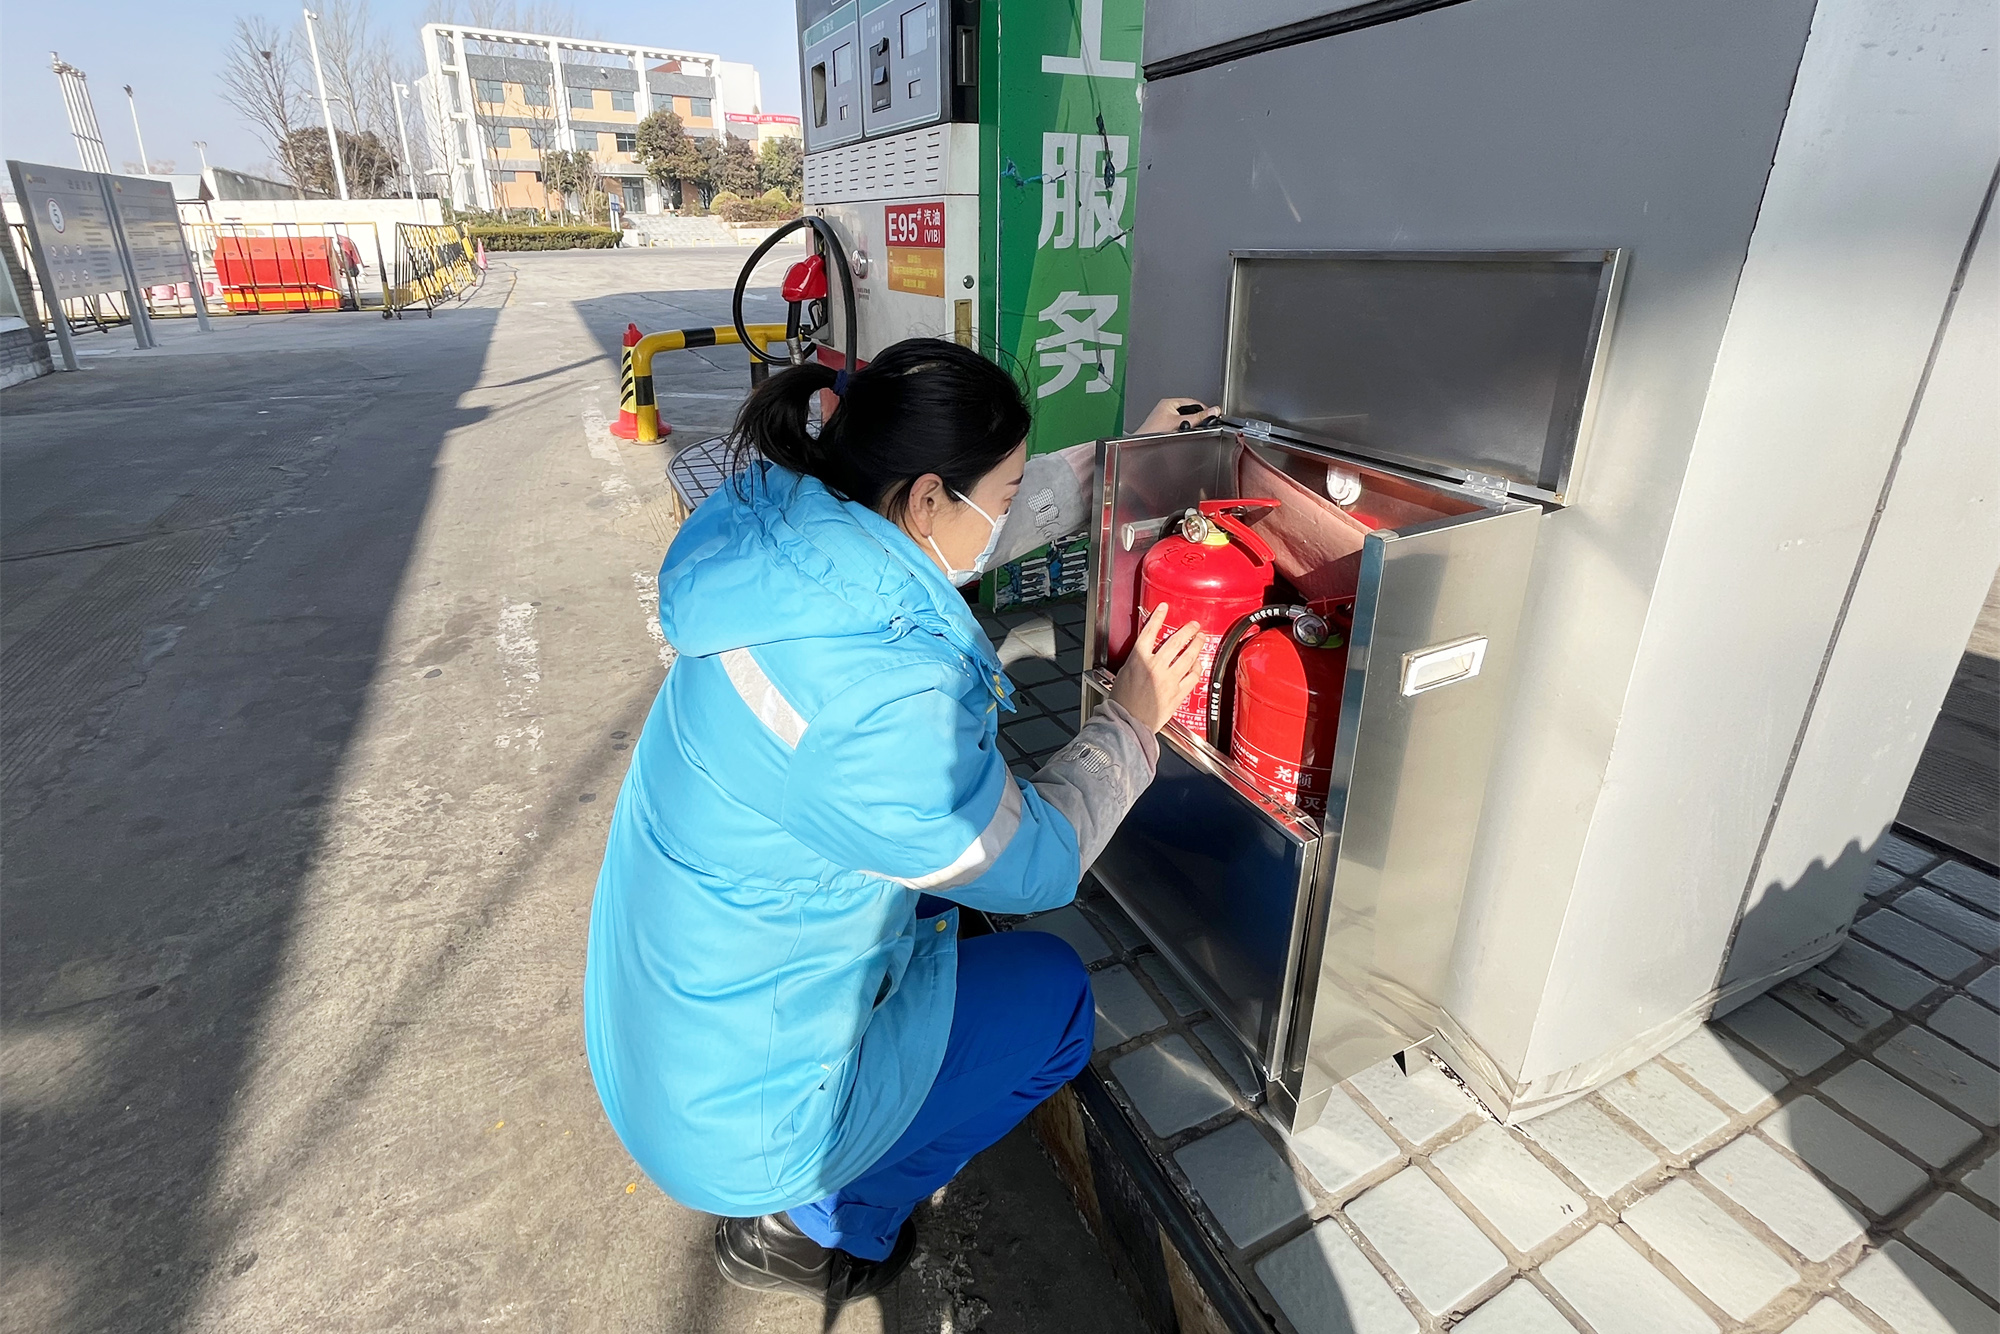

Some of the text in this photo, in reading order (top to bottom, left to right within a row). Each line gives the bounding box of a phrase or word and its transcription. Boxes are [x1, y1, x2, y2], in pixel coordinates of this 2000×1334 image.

[53, 209, 60, 224] 5
[924, 209, 941, 226] 汽油
[1036, 0, 1136, 547] 工服务
[1274, 765, 1313, 788] 尧顺
[1268, 785, 1327, 811] 干粉灭
